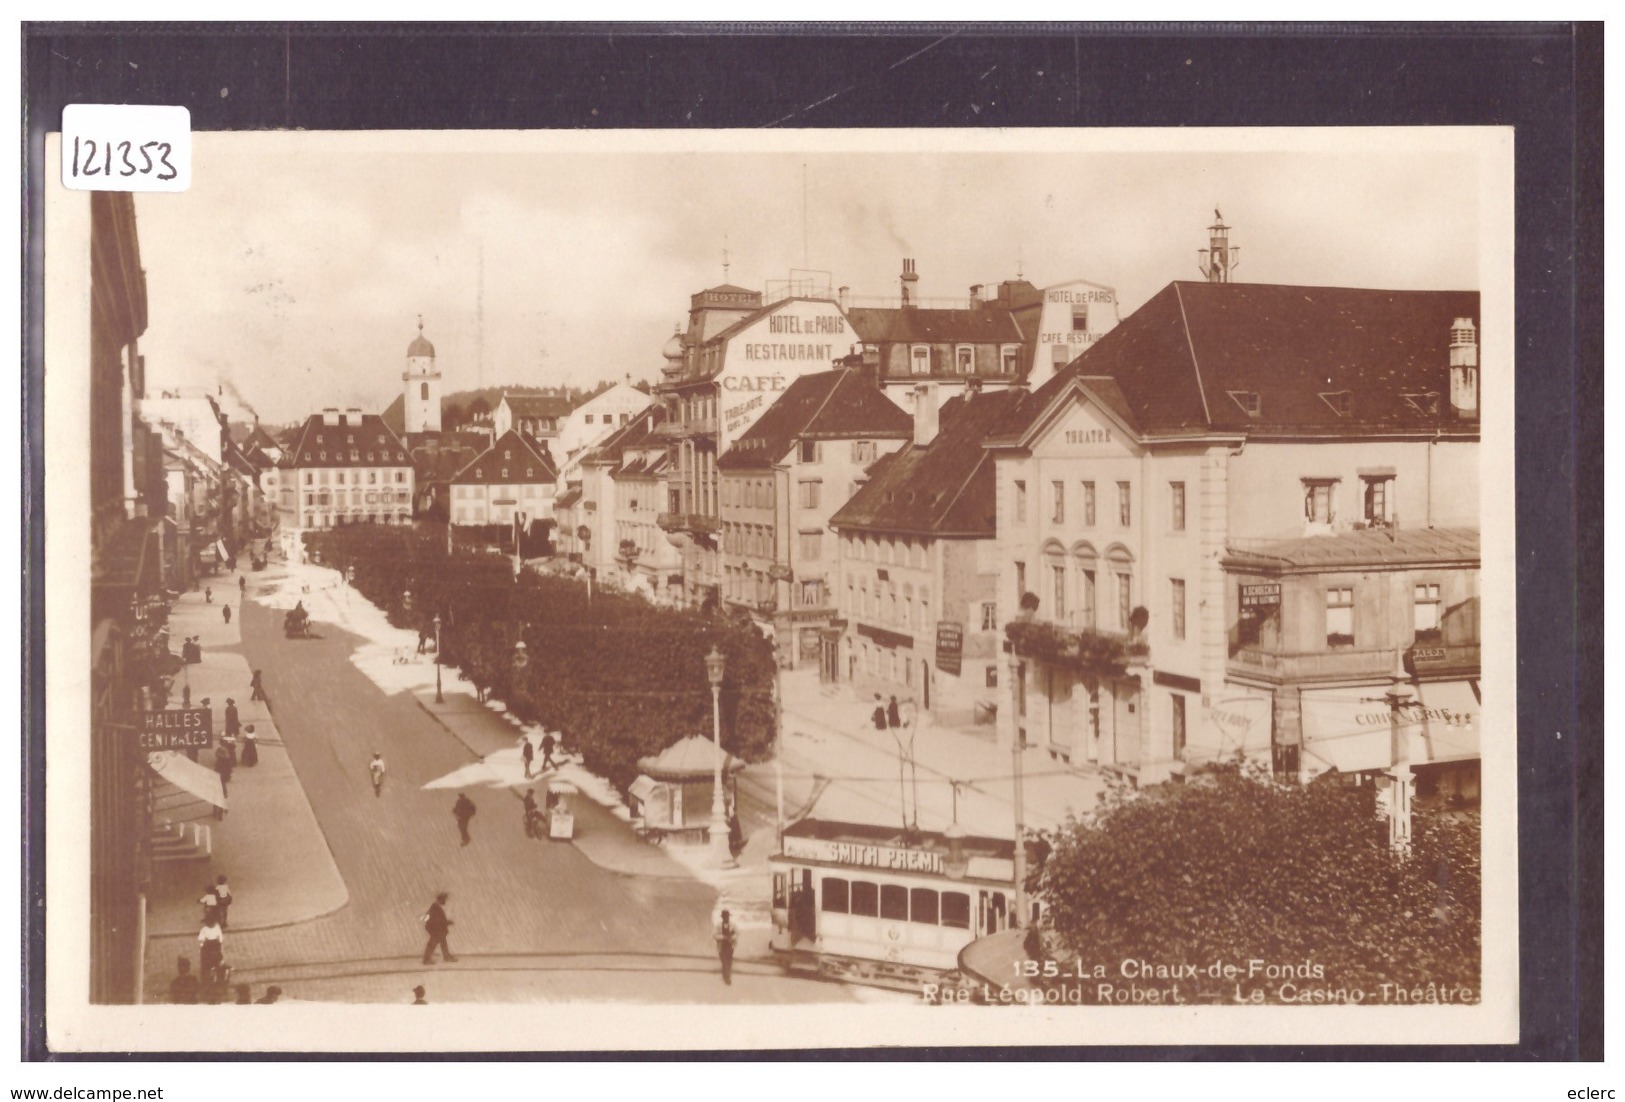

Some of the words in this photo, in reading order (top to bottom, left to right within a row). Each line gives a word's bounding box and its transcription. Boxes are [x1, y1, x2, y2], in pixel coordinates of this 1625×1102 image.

[73, 136, 177, 180] 121353
[708, 293, 756, 302] HOTEL
[1048, 291, 1073, 303] HOTEL
[1088, 291, 1113, 303] PARIS
[769, 315, 802, 334] HOTEL
[815, 315, 845, 334] PARIS
[745, 343, 832, 360] RESTAURANT
[723, 371, 786, 392] CAFÉ
[145, 712, 202, 728] HALLES
[138, 730, 208, 748] CENTRALES
[830, 843, 879, 866] SMITH
